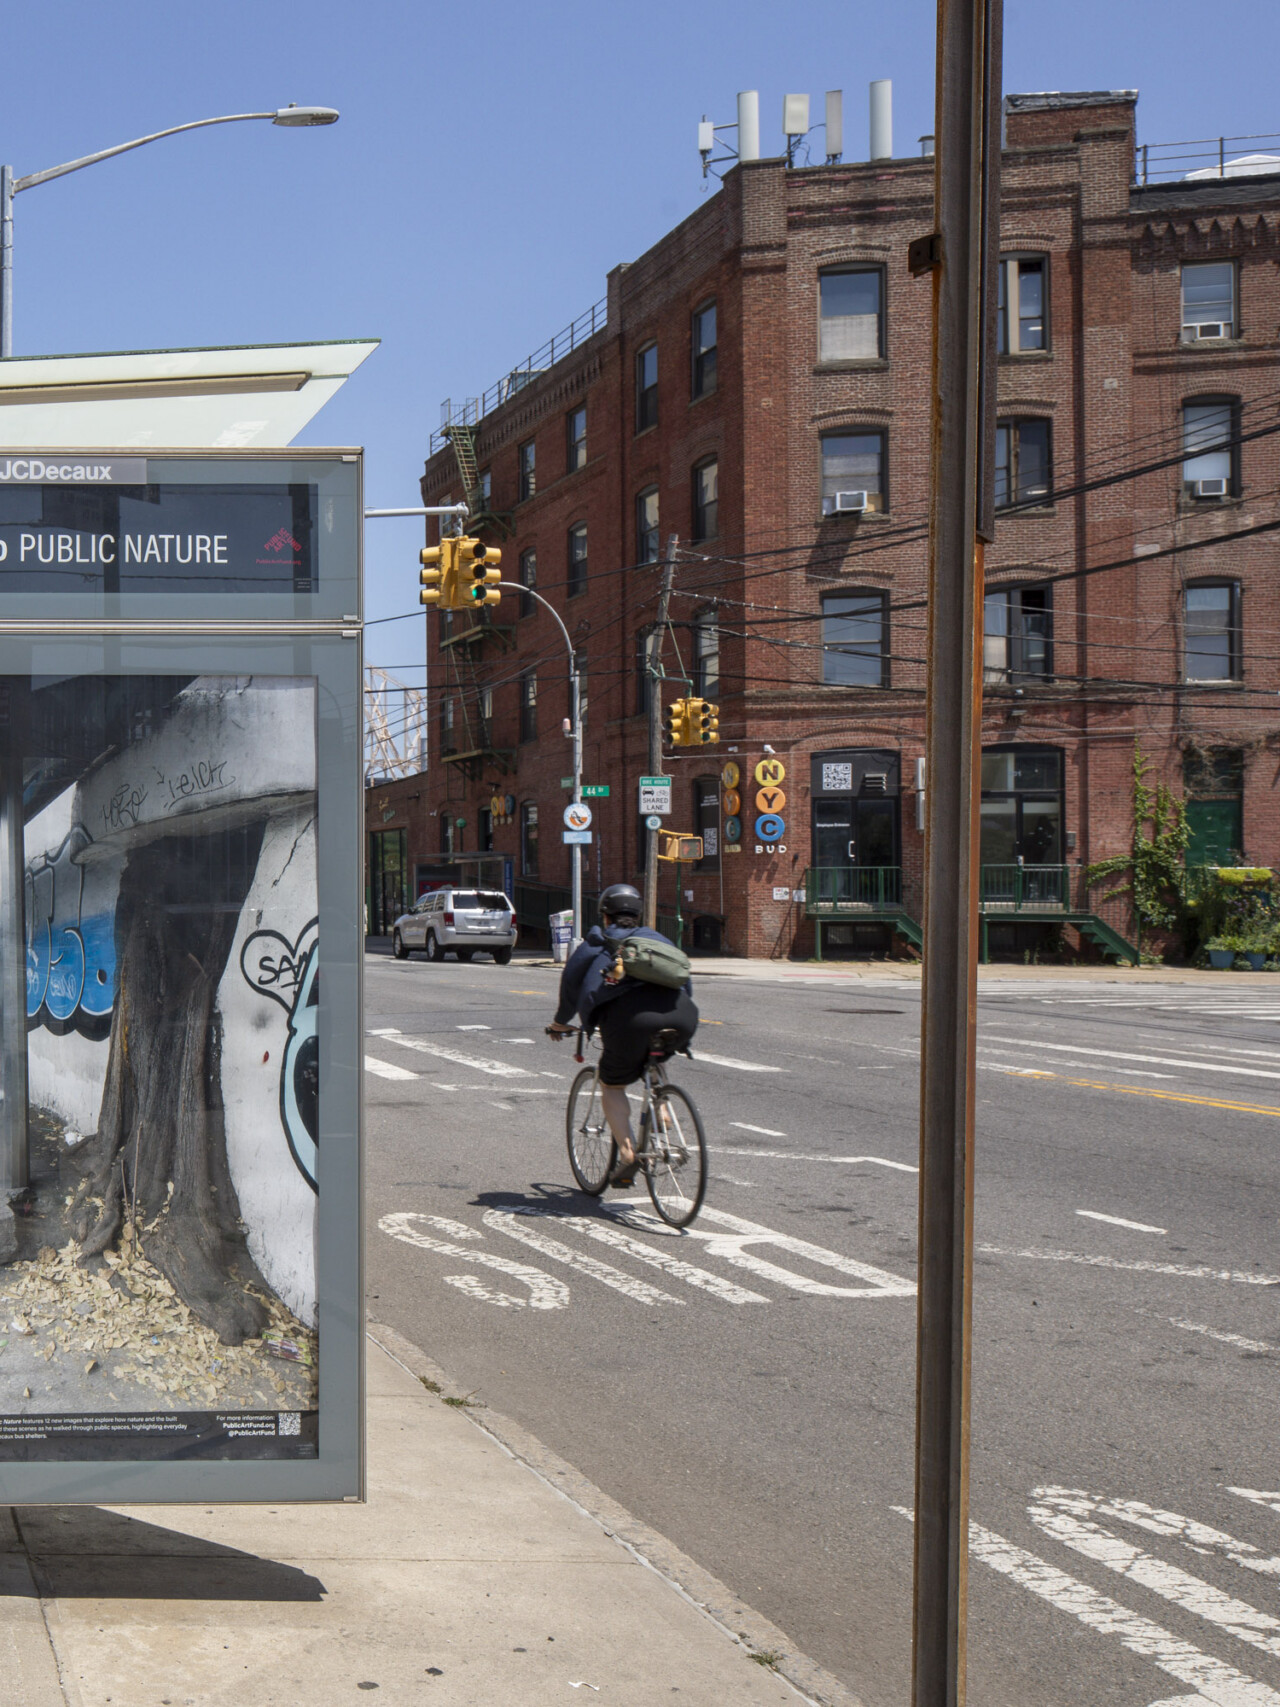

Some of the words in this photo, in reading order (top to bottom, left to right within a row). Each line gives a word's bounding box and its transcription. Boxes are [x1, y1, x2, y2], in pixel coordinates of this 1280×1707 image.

[20, 533, 115, 563] PUBLIC
[124, 534, 228, 563] NATURE
[586, 787, 596, 795] 44
[755, 845, 787, 854] BUD
[72, 1424, 93, 1432] through
[131, 1423, 163, 1431] highlighting
[163, 1423, 188, 1431] everyday
[223, 1422, 275, 1430] PublicArtFund.org
